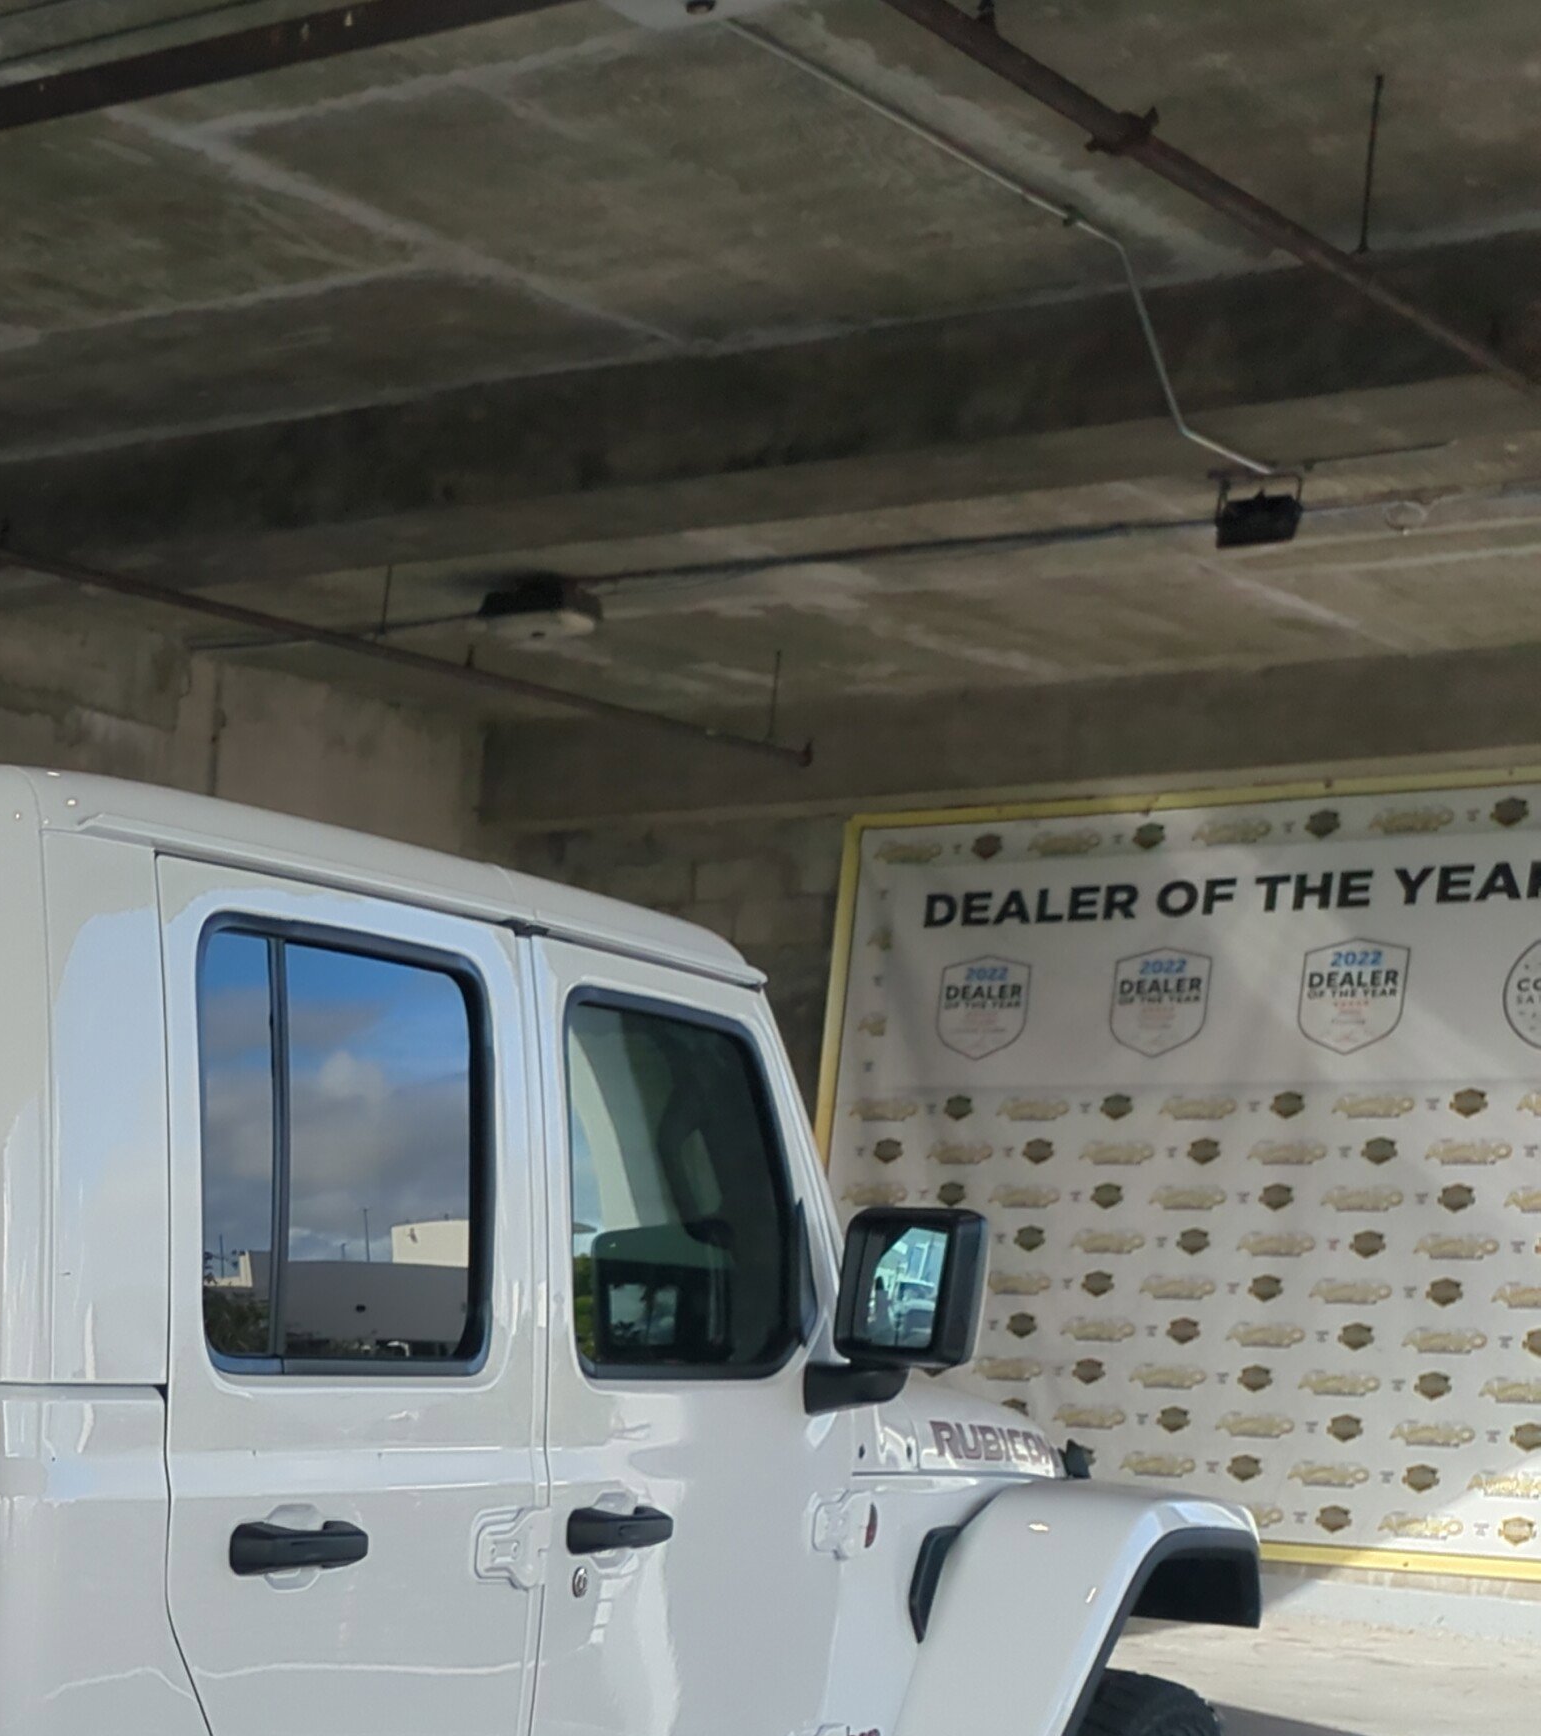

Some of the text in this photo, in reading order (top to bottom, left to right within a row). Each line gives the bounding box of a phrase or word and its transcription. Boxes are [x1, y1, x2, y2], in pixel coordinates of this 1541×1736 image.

[923, 883, 1139, 928] DEALER
[1156, 877, 1237, 918] OF
[1254, 868, 1374, 912] THE
[1139, 957, 1188, 975] 2022
[1330, 949, 1383, 967] 2022
[1119, 976, 1203, 995] DEALER
[1308, 968, 1399, 988] DEALER
[945, 983, 1023, 1001] DEALER
[1331, 988, 1357, 998] THE
[1363, 987, 1398, 998] YEAR
